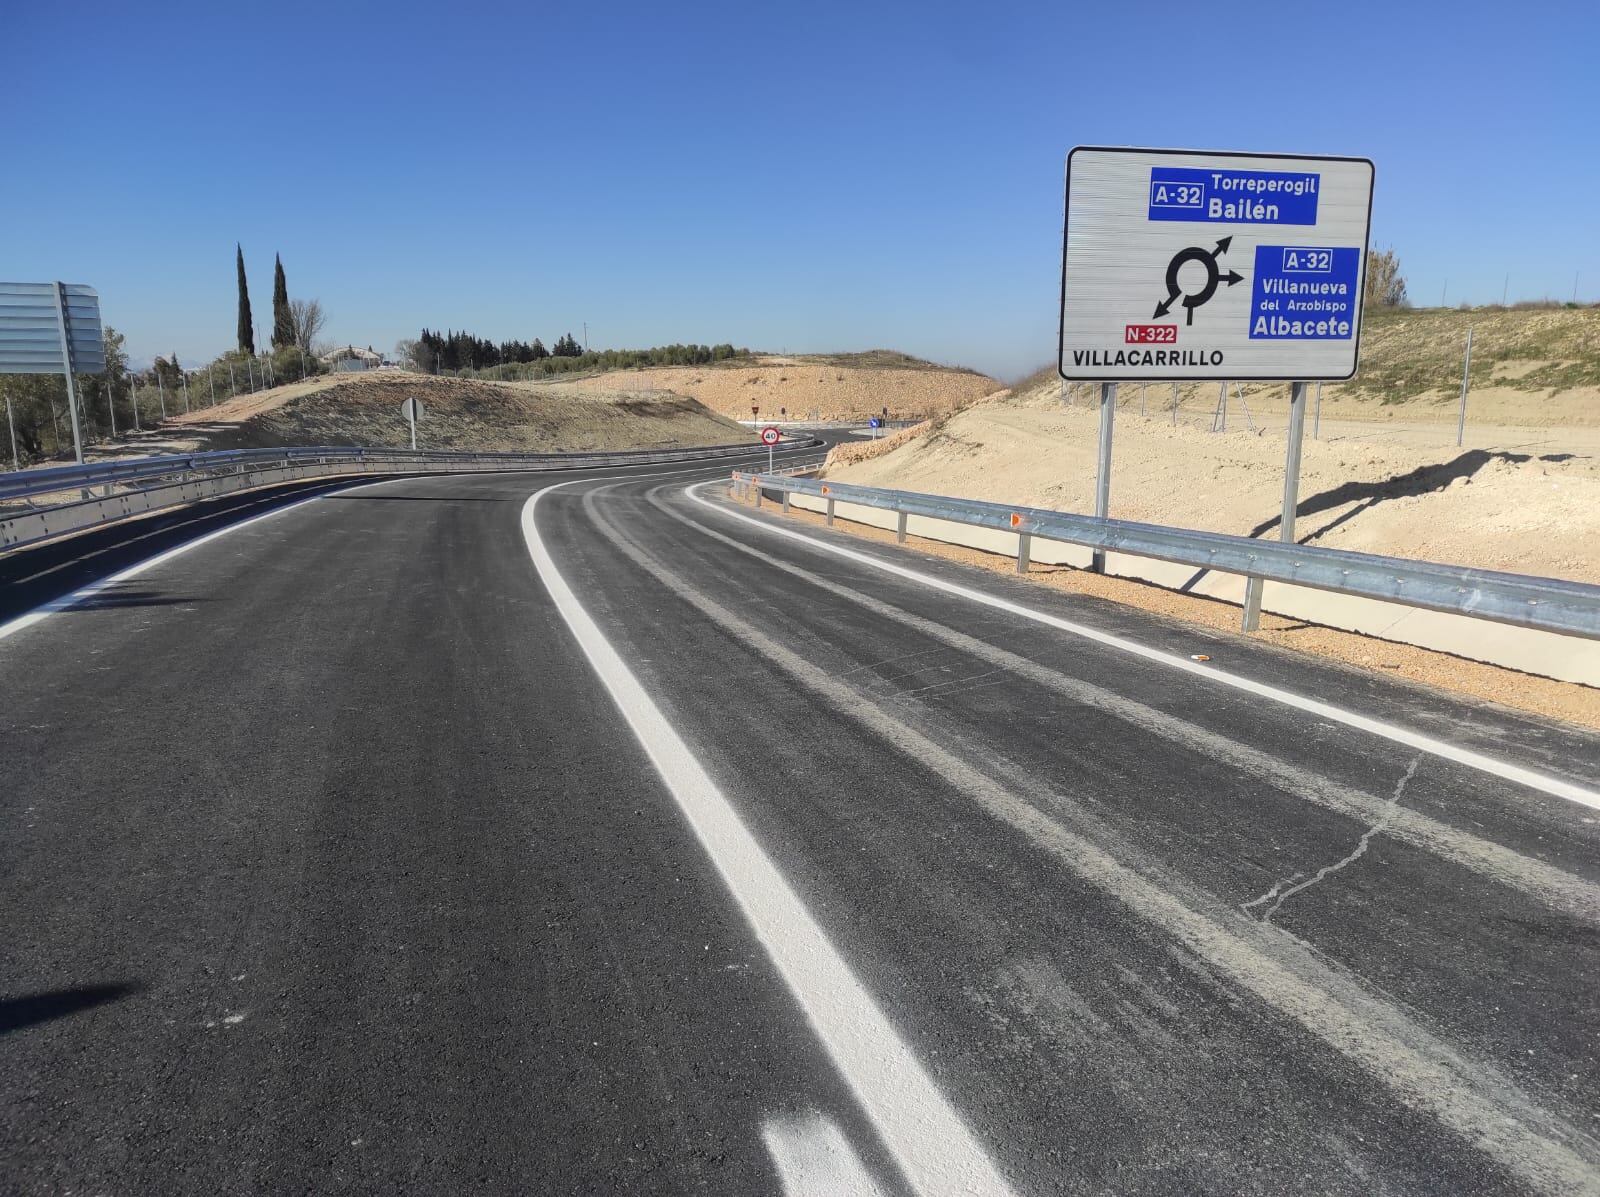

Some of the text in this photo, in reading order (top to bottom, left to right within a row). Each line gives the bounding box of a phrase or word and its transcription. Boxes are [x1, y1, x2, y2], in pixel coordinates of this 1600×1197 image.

[1211, 173, 1316, 195] Torreperogil
[1155, 186, 1200, 204] A-32
[1208, 198, 1279, 220] Bailén
[1286, 252, 1329, 269] A-32
[1262, 278, 1347, 295] Villanueva
[1260, 300, 1347, 313] del Arzobispo
[1127, 327, 1175, 342] N-322
[1253, 316, 1350, 336] Albacete
[1073, 350, 1224, 366] VILLACARRILLO
[765, 432, 776, 440] 40
